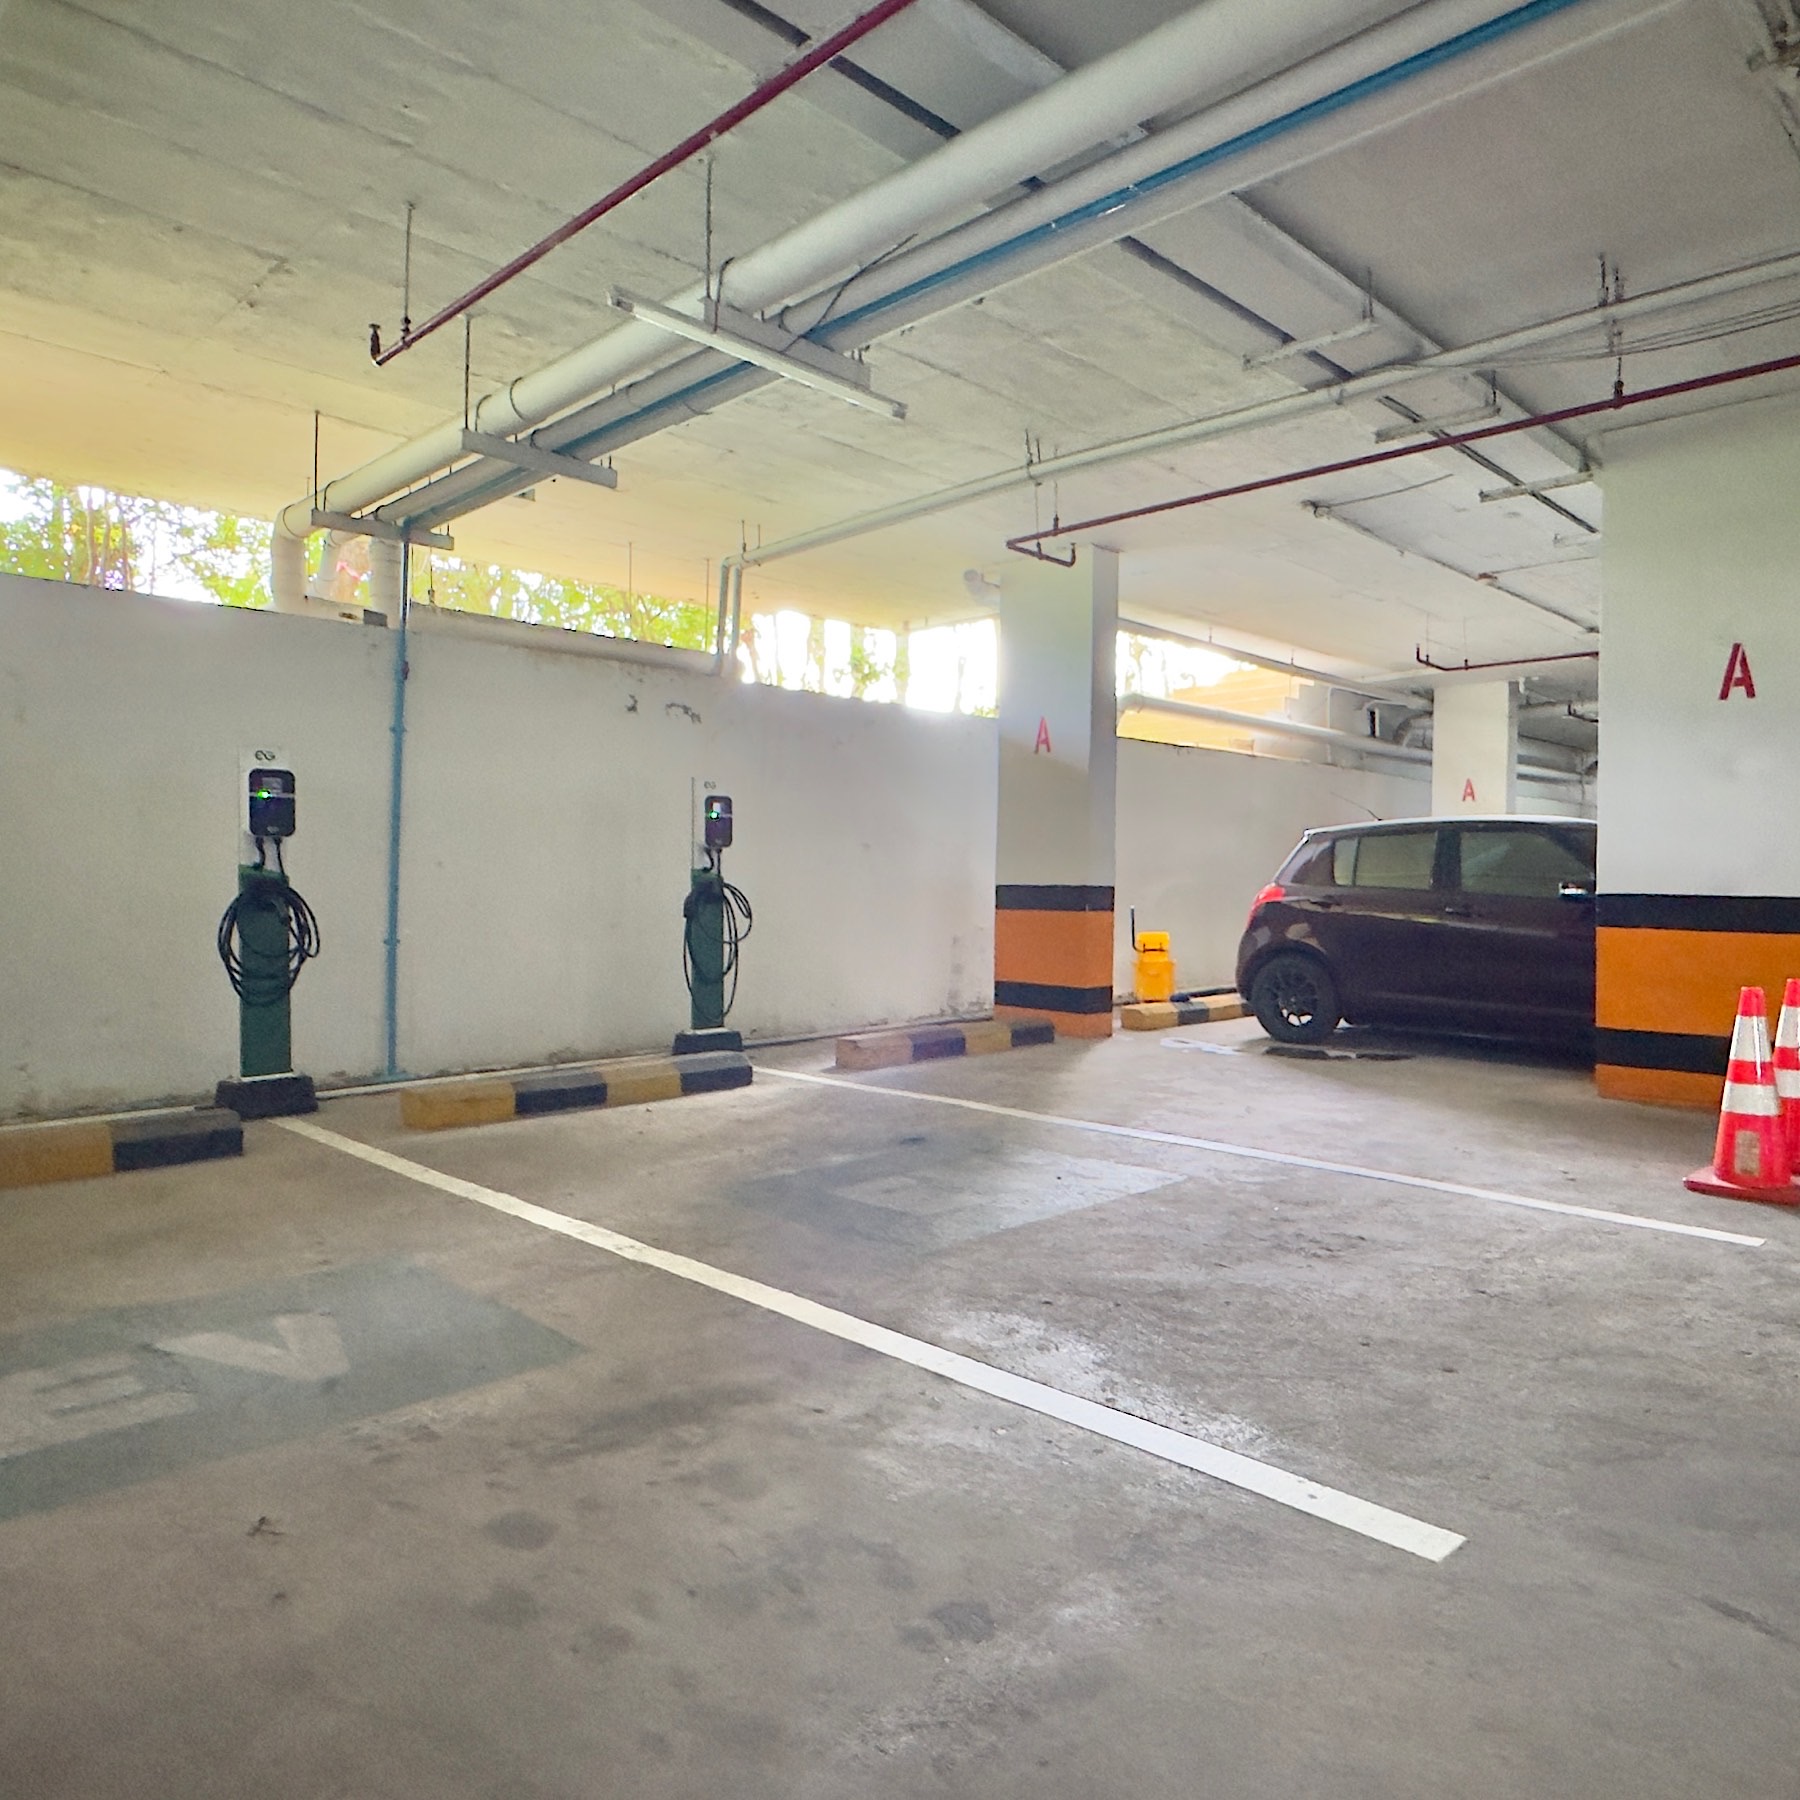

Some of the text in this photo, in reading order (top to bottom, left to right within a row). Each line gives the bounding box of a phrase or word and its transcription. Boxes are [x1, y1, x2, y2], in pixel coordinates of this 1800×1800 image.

[1719, 642, 1756, 701] A
[1034, 715, 1051, 754] A
[1462, 777, 1475, 802] A
